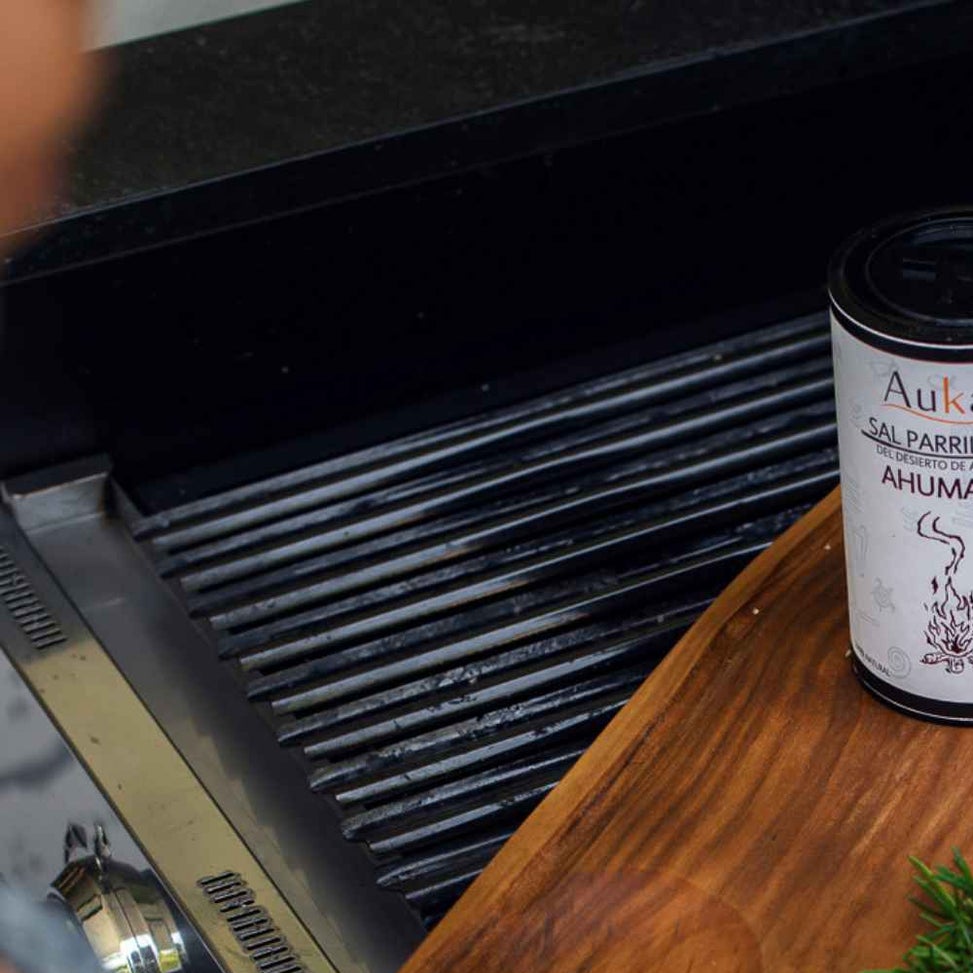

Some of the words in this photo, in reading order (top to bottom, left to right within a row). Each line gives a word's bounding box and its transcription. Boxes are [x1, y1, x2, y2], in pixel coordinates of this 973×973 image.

[867, 416, 902, 445] SAL
[876, 443, 895, 460] DEL
[895, 453, 948, 471] DESIERTO
[950, 460, 966, 471] DE
